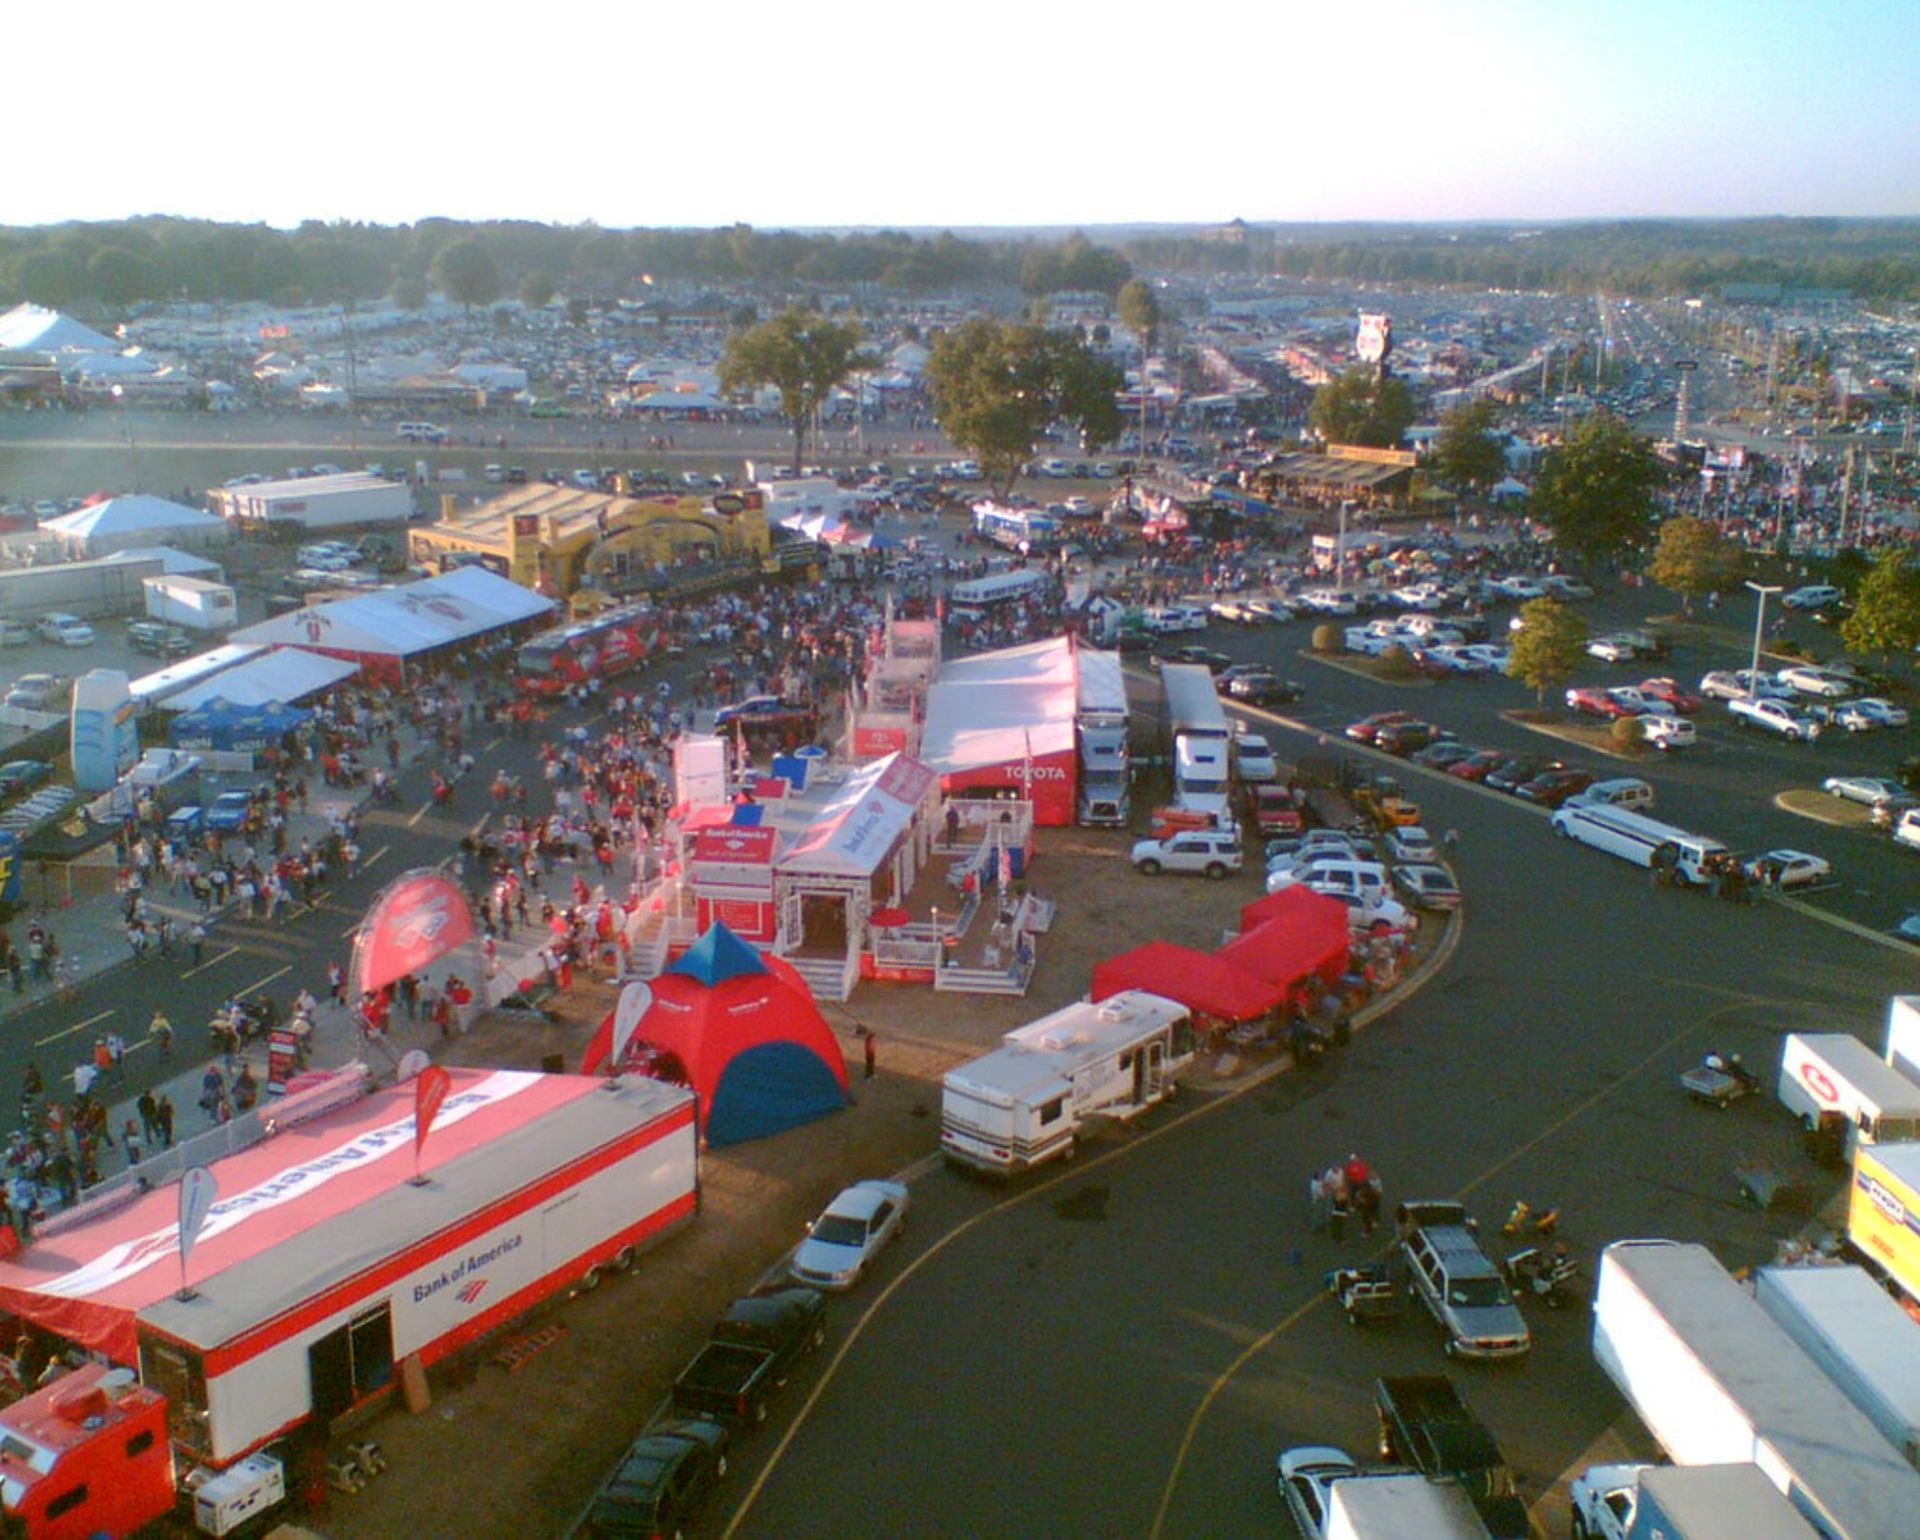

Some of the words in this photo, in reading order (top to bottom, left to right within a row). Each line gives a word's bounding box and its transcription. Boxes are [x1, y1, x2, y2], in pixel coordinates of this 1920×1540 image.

[208, 1147, 368, 1216] America
[413, 1270, 449, 1303] Bank
[451, 1260, 466, 1283] of
[467, 1234, 523, 1274] America
